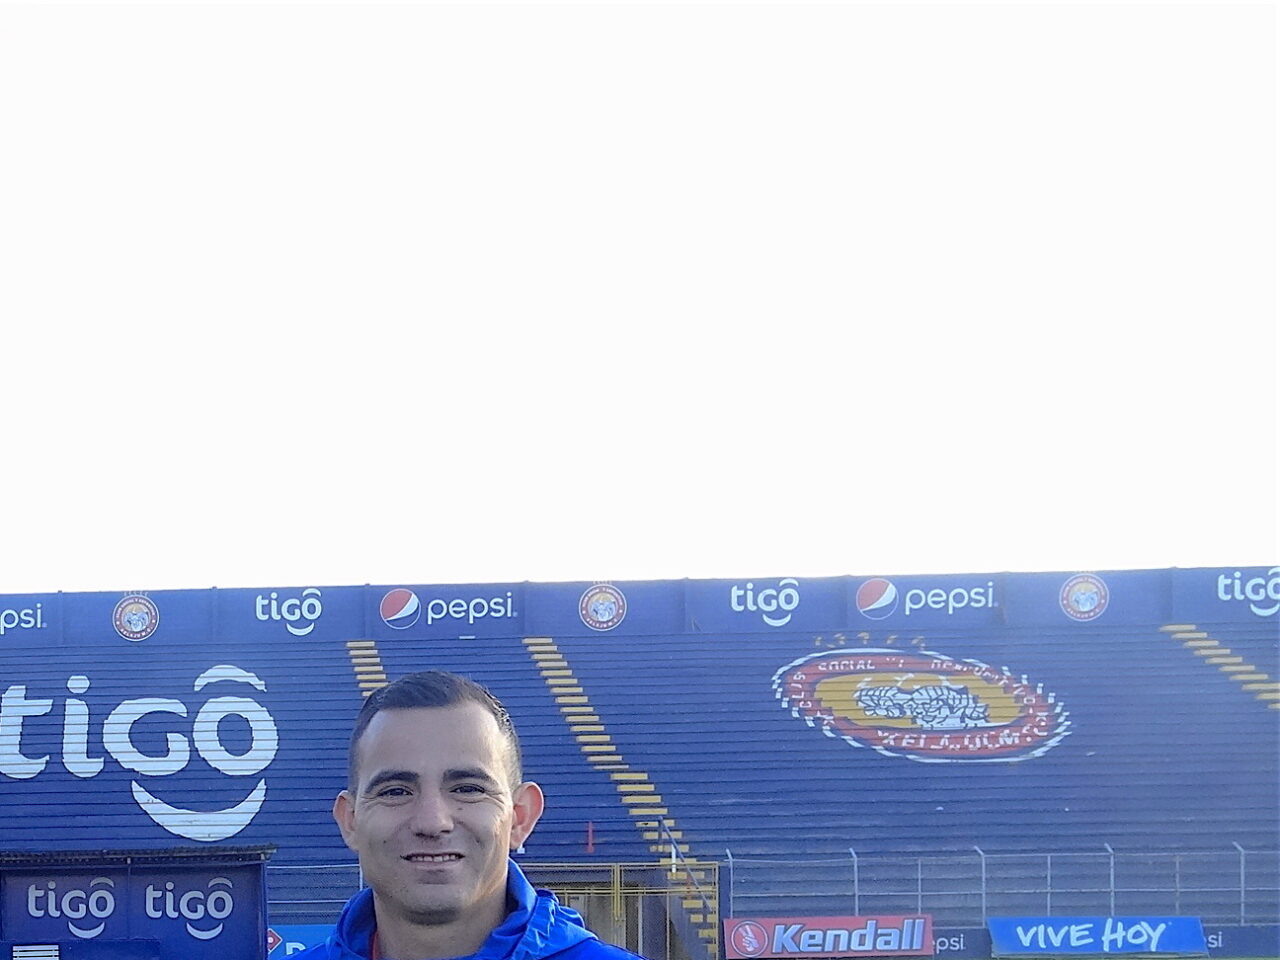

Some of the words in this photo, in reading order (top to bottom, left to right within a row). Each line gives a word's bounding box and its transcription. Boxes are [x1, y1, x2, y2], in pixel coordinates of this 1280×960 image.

[255, 588, 322, 621] tigo
[427, 592, 512, 624] pepsi
[731, 578, 800, 612] tigo
[905, 582, 994, 614] pepsi
[28, 877, 115, 919] tigo
[145, 877, 233, 919] tigo
[772, 919, 926, 954] Kendall
[932, 934, 964, 954] psi
[1016, 923, 1095, 948] VIVE
[1102, 916, 1168, 952] HOY
